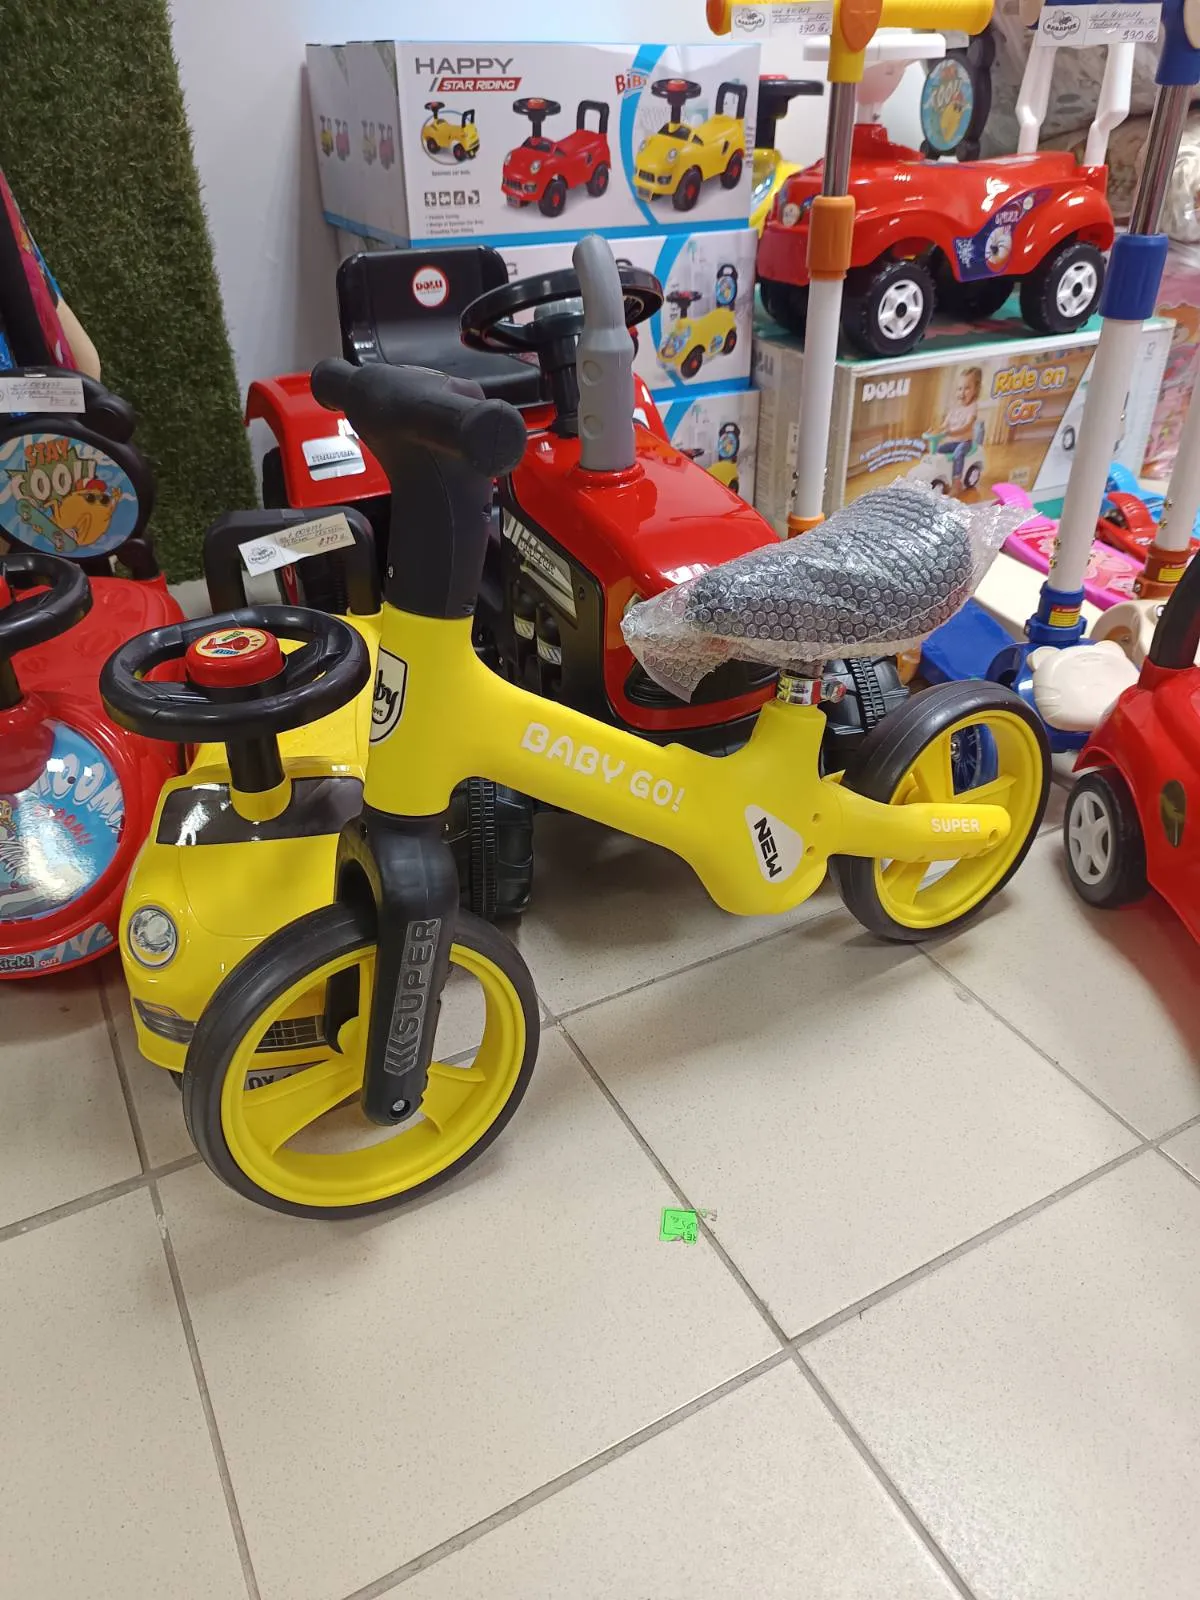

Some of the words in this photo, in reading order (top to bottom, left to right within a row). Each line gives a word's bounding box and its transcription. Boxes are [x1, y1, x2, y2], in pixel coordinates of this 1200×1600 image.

[415, 57, 514, 75] HAPPY
[442, 80, 474, 91] STAR
[476, 80, 516, 90] RIDING
[992, 367, 1038, 396] Ride
[1041, 367, 1066, 387] on
[1008, 400, 1040, 423] Car
[25, 437, 69, 468] STAY
[374, 669, 399, 724] by
[521, 722, 625, 784] BABY
[629, 770, 685, 813] GO!
[931, 817, 981, 833] SUPER
[754, 817, 782, 878] NEW
[395, 919, 442, 1034] SUPER
